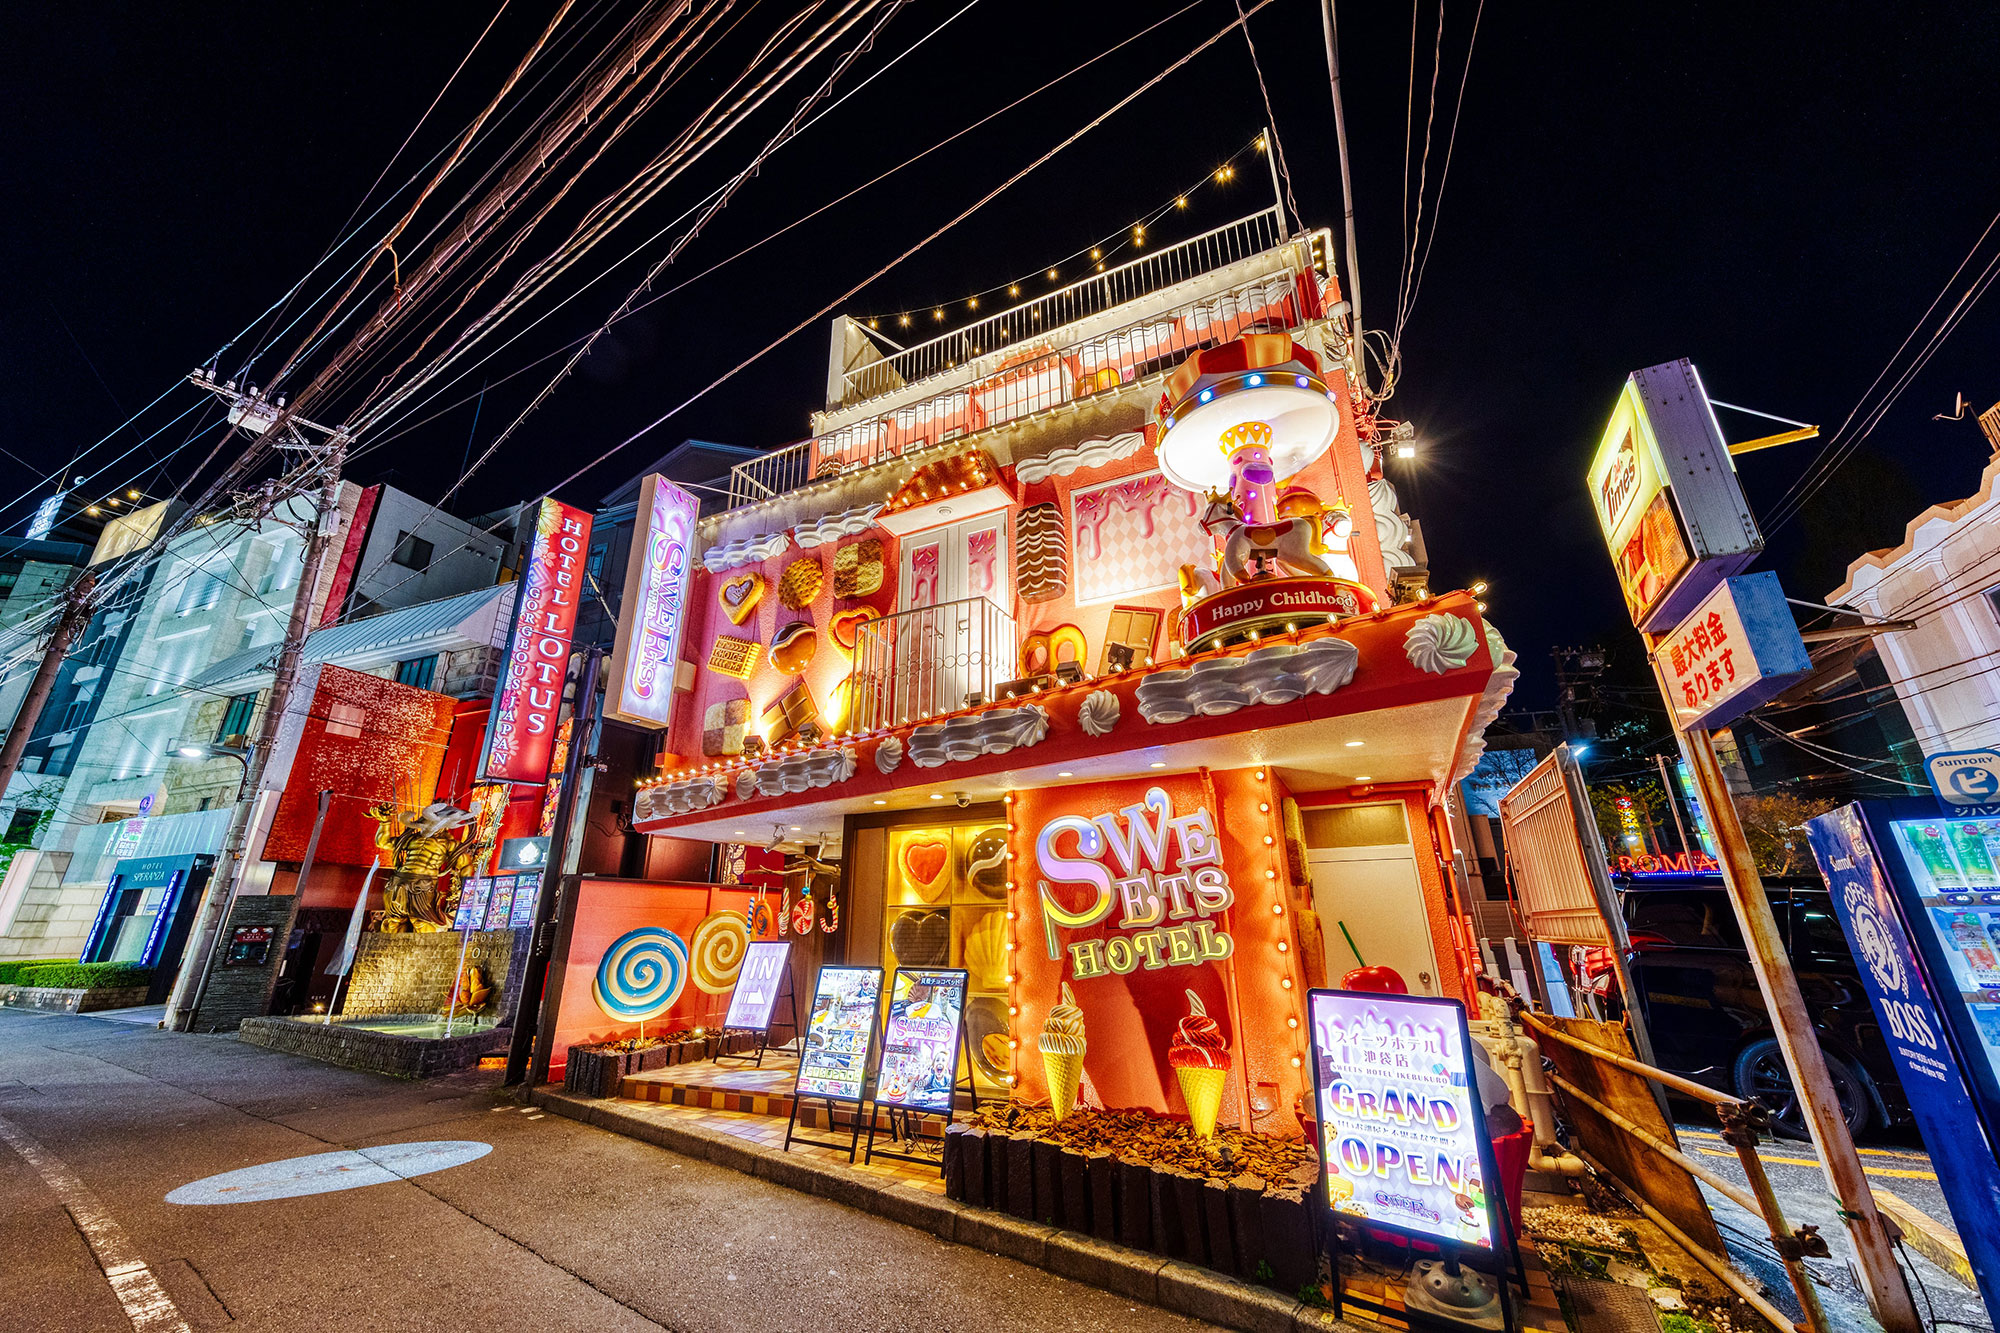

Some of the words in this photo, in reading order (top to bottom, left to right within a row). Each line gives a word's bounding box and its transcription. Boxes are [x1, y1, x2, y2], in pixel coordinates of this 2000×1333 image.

[551, 516, 583, 606] HOTEL
[1211, 598, 1264, 622] Happy
[1269, 590, 1354, 608] Childhood
[510, 585, 542, 692] GORGEOUS
[1669, 611, 1728, 678] 最大料金
[526, 611, 568, 735] LOTUS
[1682, 648, 1735, 708] あります
[493, 695, 517, 767] JAPAN
[142, 861, 163, 870] HOTEL
[1843, 881, 1876, 914] COFFEE
[748, 955, 777, 981] IN
[1069, 920, 1234, 978] HOTEL
[1335, 1031, 1438, 1055] スイーツホテル
[1879, 998, 1938, 1051] BOSS
[1332, 1063, 1363, 1073] SWEETS
[1366, 1068, 1393, 1078] HOTEL
[1396, 1072, 1449, 1085] IKEBUKURO
[1363, 1049, 1409, 1069] 池袋店
[1330, 1081, 1459, 1129] GRAND
[1341, 1137, 1462, 1190] OPEN
